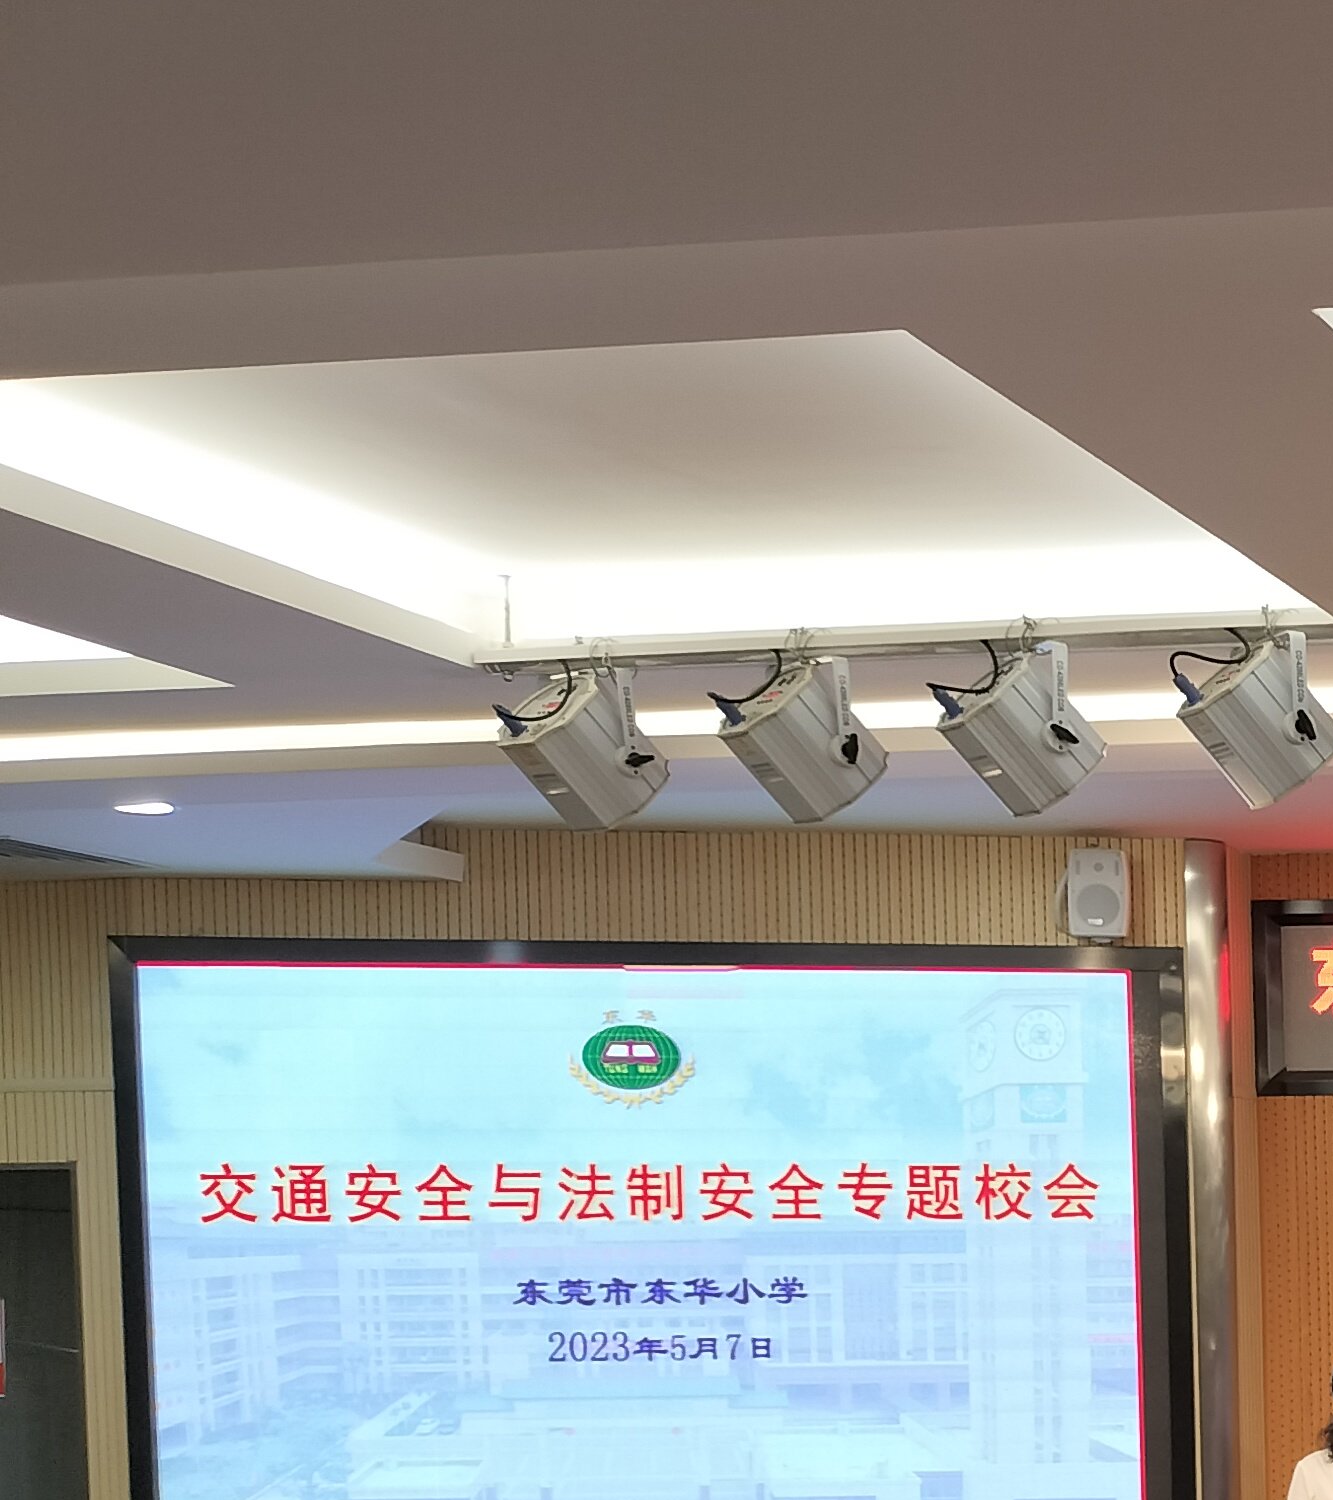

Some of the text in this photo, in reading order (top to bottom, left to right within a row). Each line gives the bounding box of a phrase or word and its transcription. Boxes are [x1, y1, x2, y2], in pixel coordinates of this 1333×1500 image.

[200, 1161, 1100, 1226] 交通安全与法制安全专题校会
[513, 1275, 808, 1307] 东莞市东华小学
[548, 1330, 774, 1365] 2023年5月7日
